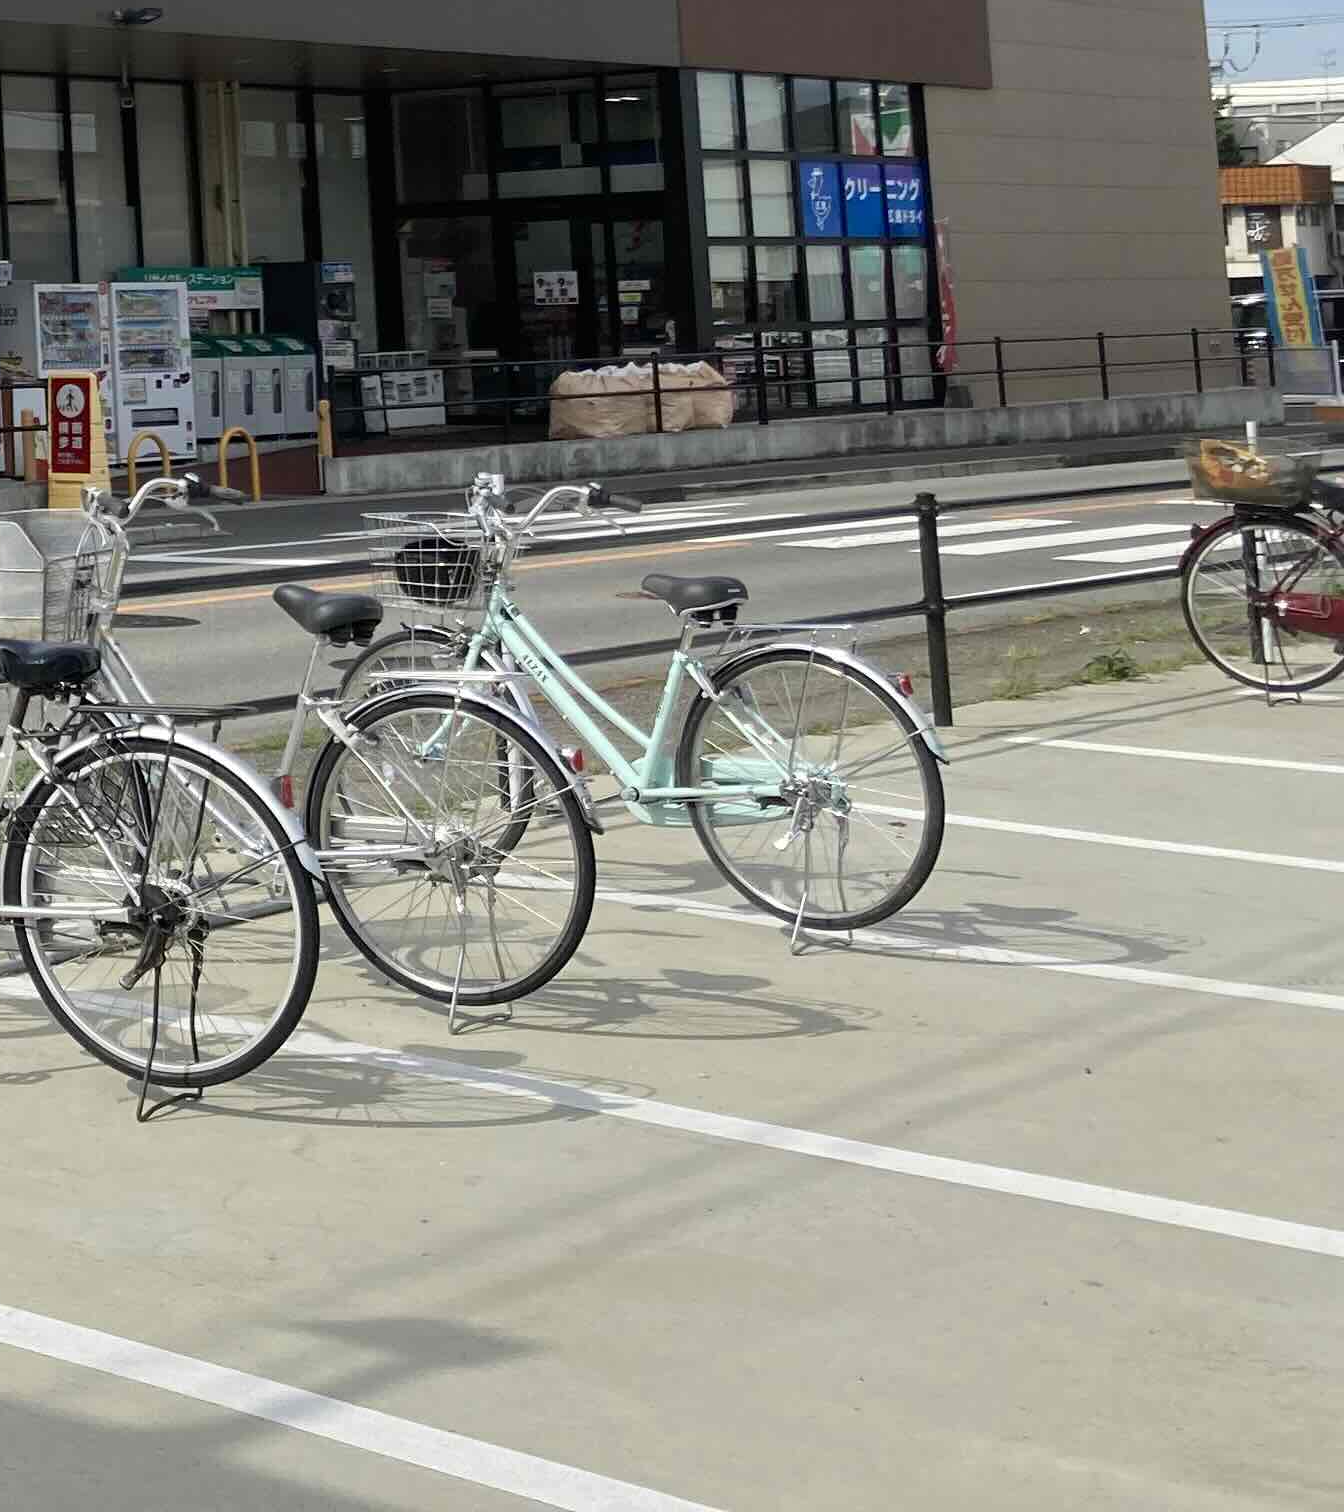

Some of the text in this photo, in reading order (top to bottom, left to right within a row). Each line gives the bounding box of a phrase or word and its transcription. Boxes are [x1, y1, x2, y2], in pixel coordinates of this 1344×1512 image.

[844, 176, 920, 200] クリーニング
